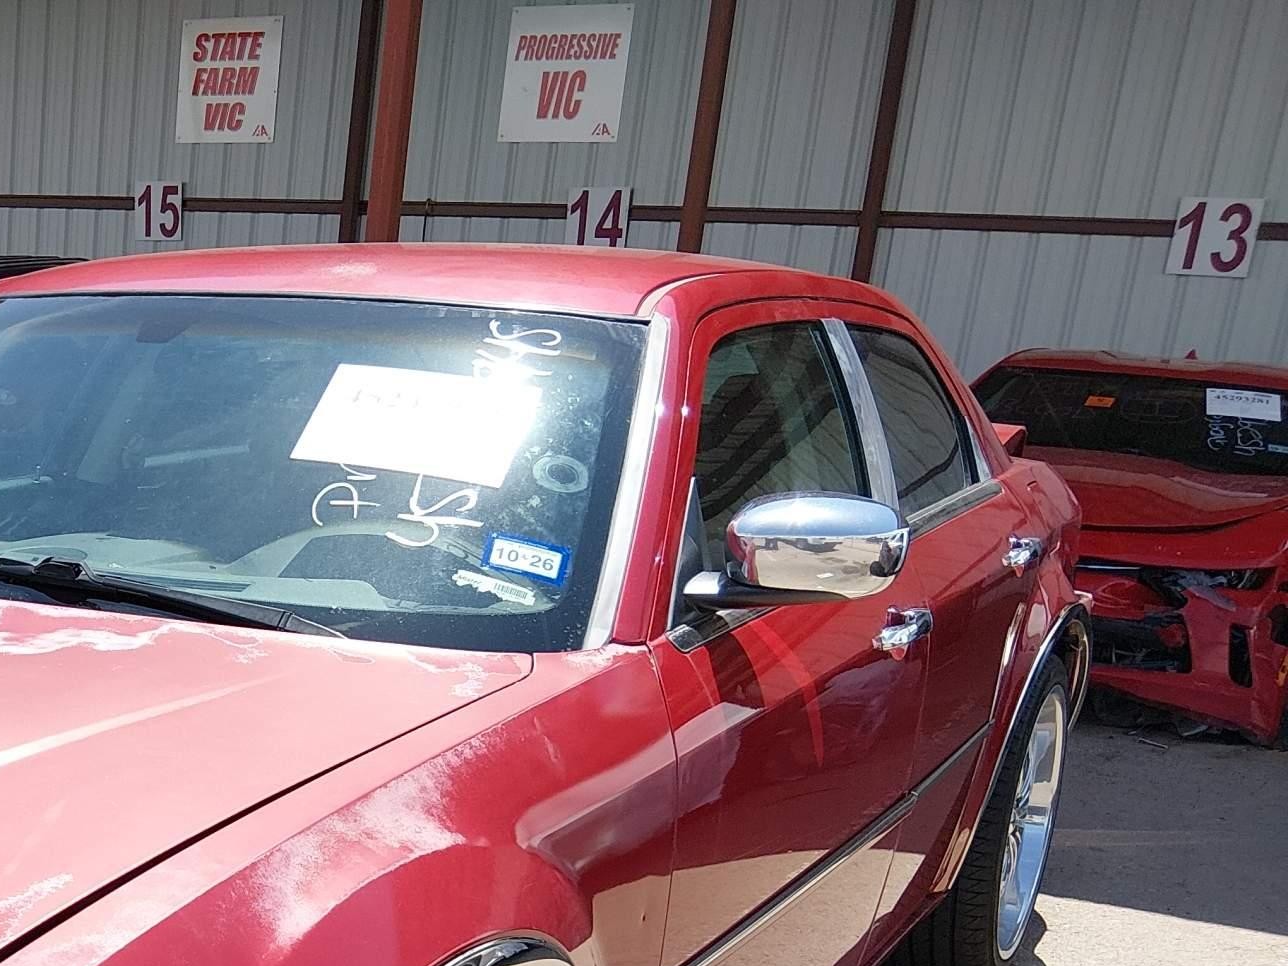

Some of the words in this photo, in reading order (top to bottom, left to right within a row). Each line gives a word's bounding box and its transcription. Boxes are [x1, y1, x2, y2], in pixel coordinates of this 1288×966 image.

[192, 31, 266, 62] STATE
[514, 33, 622, 61] PROGRESSIVE
[191, 66, 260, 96] FARM
[536, 69, 587, 120] VIC
[203, 102, 246, 132] VIC
[137, 184, 180, 238] 15
[570, 189, 623, 248] 14
[1178, 201, 1252, 273] 13
[496, 547, 520, 562] 10
[529, 554, 555, 572] 26
